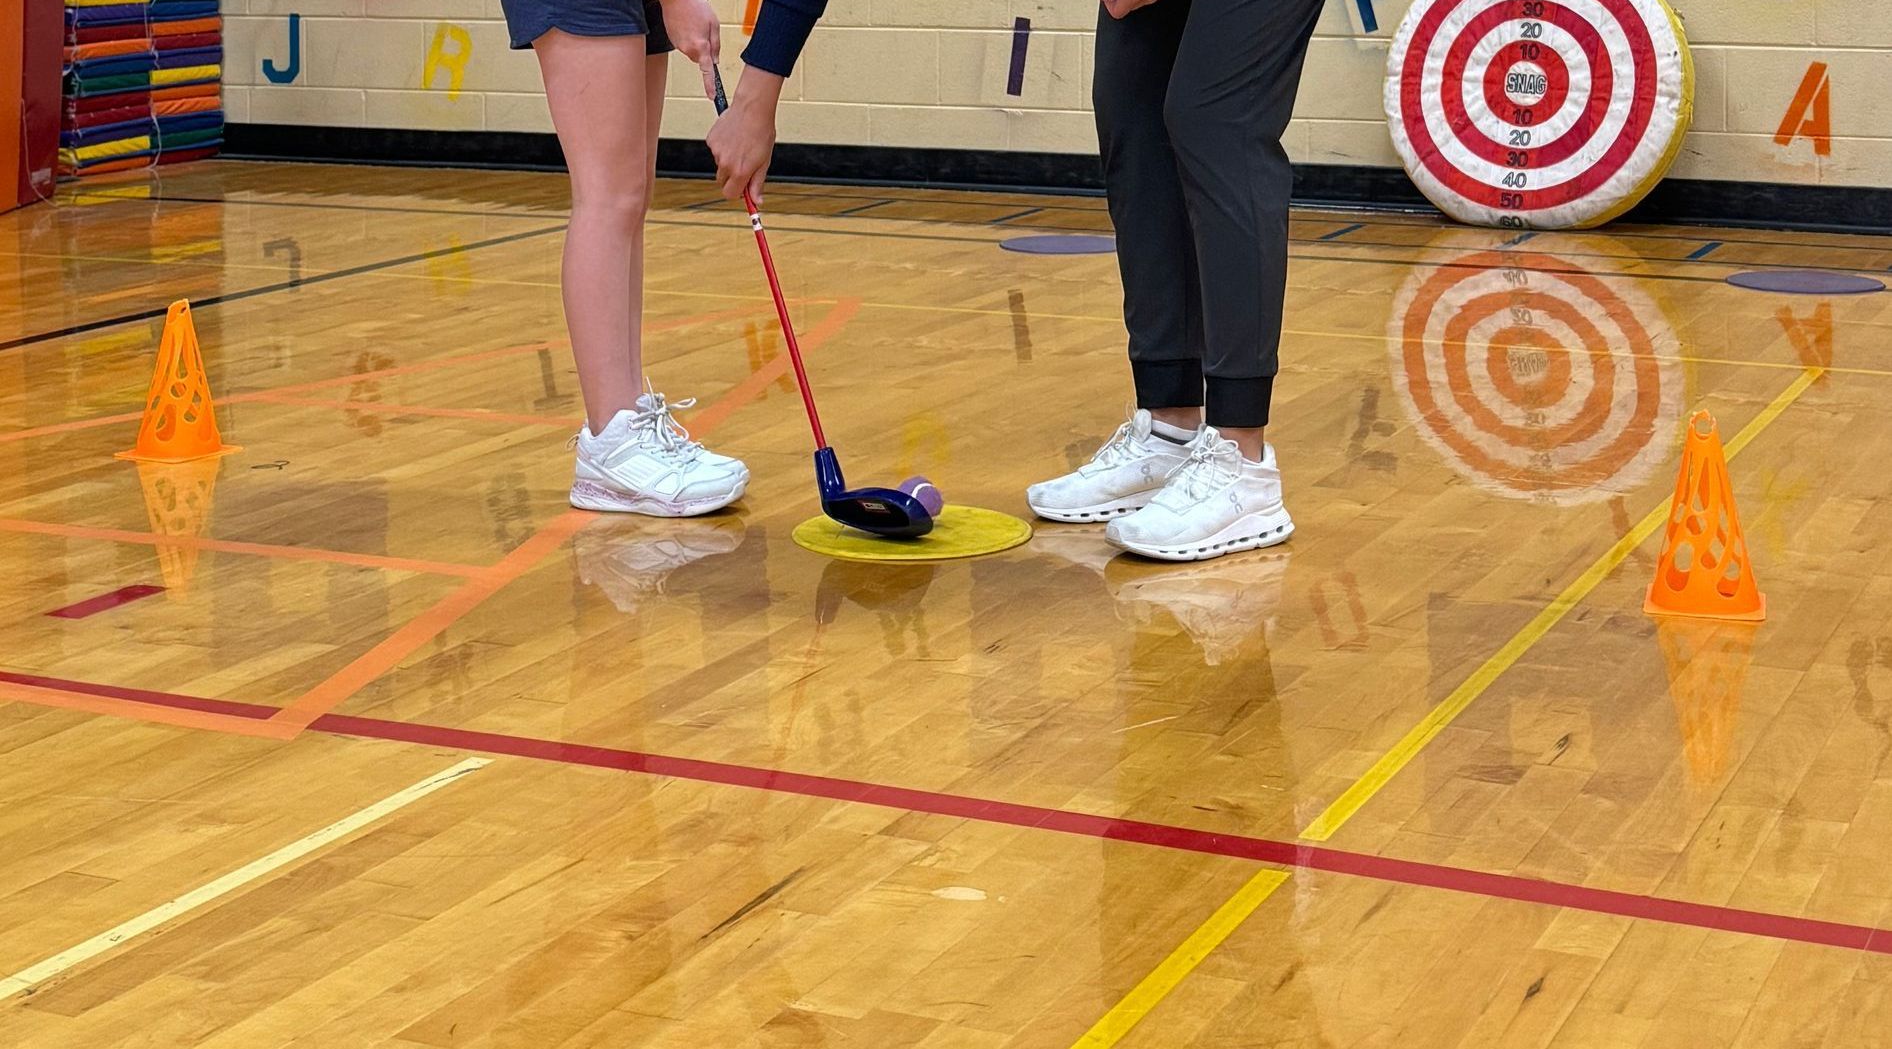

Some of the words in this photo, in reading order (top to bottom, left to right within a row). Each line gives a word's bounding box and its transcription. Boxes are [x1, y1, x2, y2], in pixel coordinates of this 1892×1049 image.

[1522, 2, 1544, 17] 30
[1520, 23, 1542, 38] 20
[262, 14, 299, 83] J
[1520, 44, 1540, 60] 10
[422, 21, 472, 102] R
[1007, 17, 1030, 97] I
[1506, 73, 1547, 95] SNAG
[1513, 109, 1533, 125] 10
[1773, 62, 1831, 156] A
[1509, 130, 1531, 146] 20
[1506, 152, 1528, 167] 30
[1502, 173, 1527, 188] 40
[1500, 193, 1524, 209] 50
[1500, 216, 1523, 228] 60
